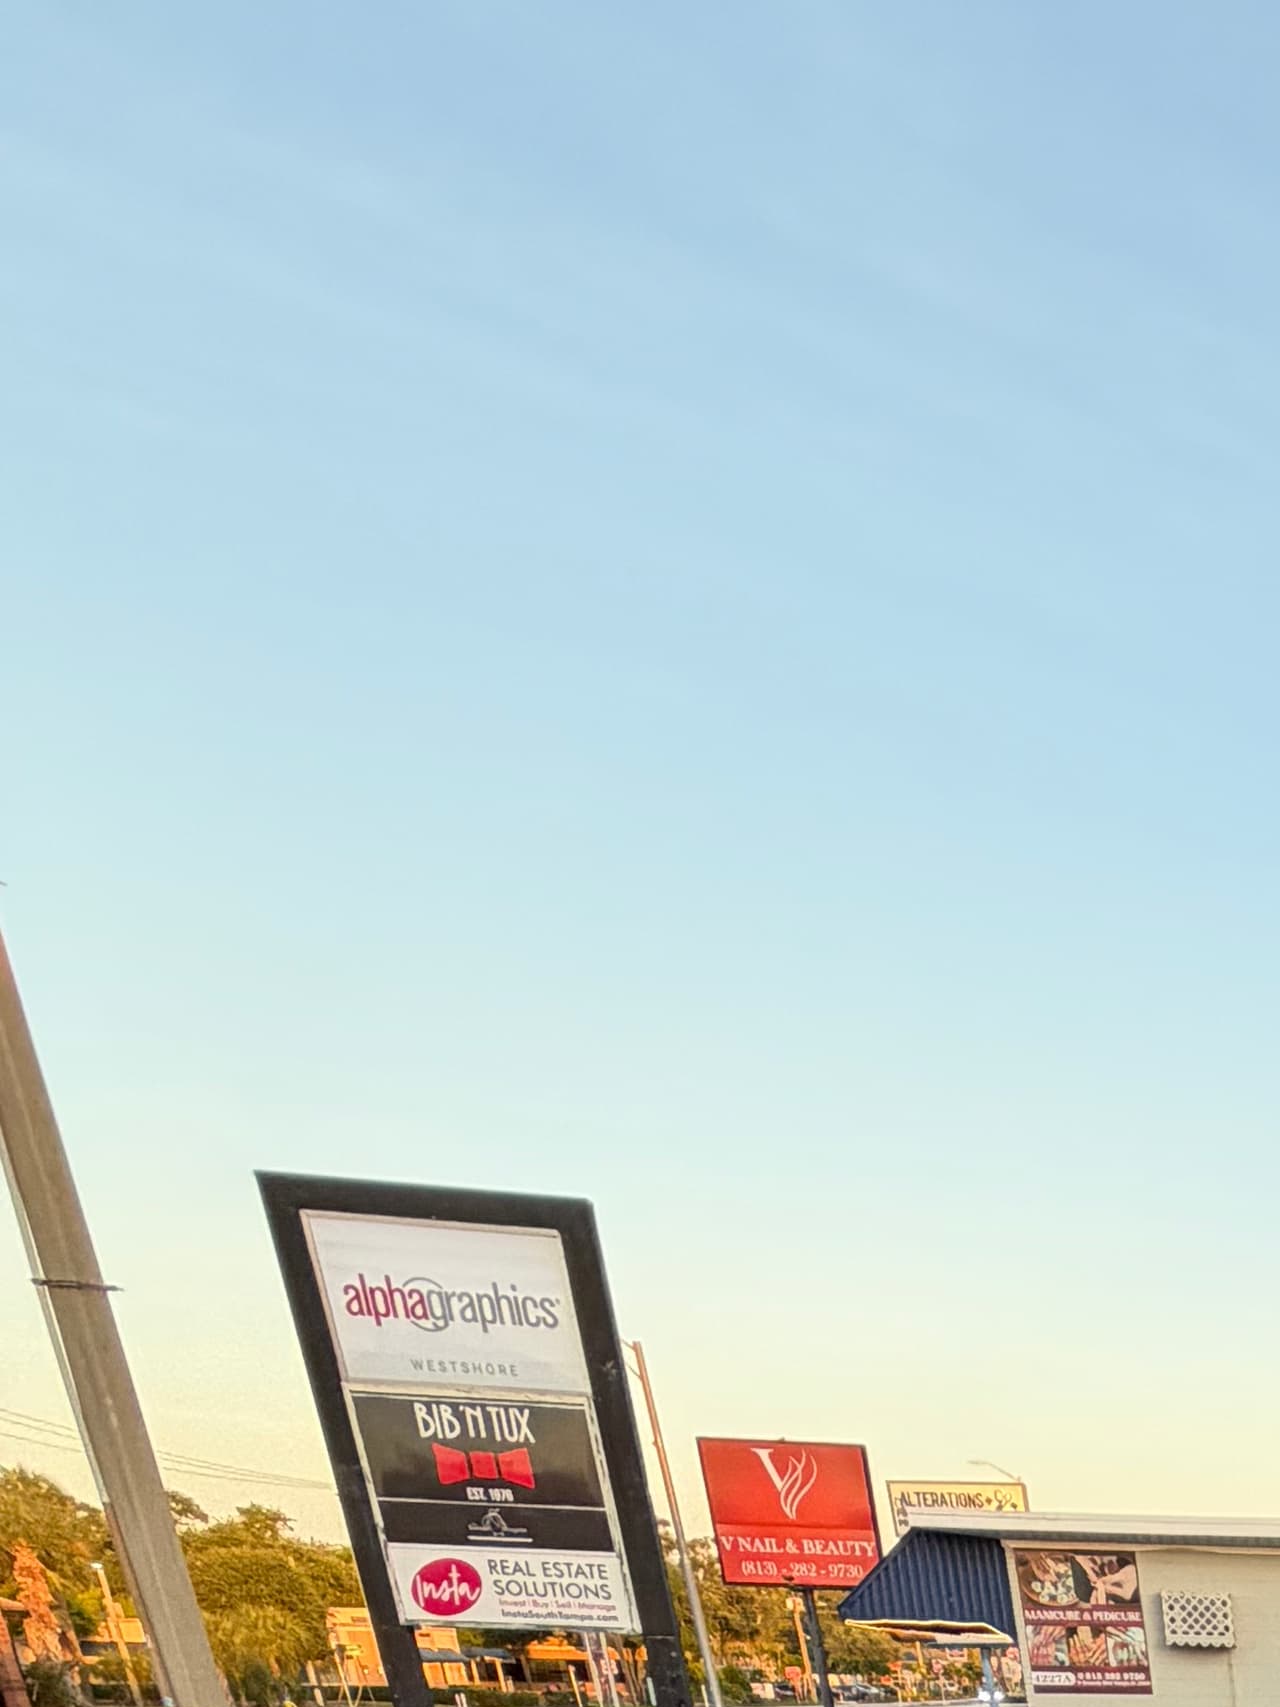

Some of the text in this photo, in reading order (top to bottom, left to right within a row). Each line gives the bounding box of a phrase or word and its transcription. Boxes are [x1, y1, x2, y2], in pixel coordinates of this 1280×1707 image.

[343, 1273, 559, 1333] alphagraphics
[410, 1358, 519, 1377] WESTSHORE
[413, 1402, 461, 1439] BIB
[486, 1406, 536, 1444] TUX
[900, 1491, 985, 1509] ALTERATIONS
[719, 1536, 877, 1558] V NAIL & BEAUTY
[487, 1559, 609, 1581] REAL ESTATE
[790, 1562, 817, 1578] 282
[829, 1563, 865, 1579] 9730
[415, 1563, 481, 1608] Insta
[493, 1579, 612, 1601] SOLUTIONS
